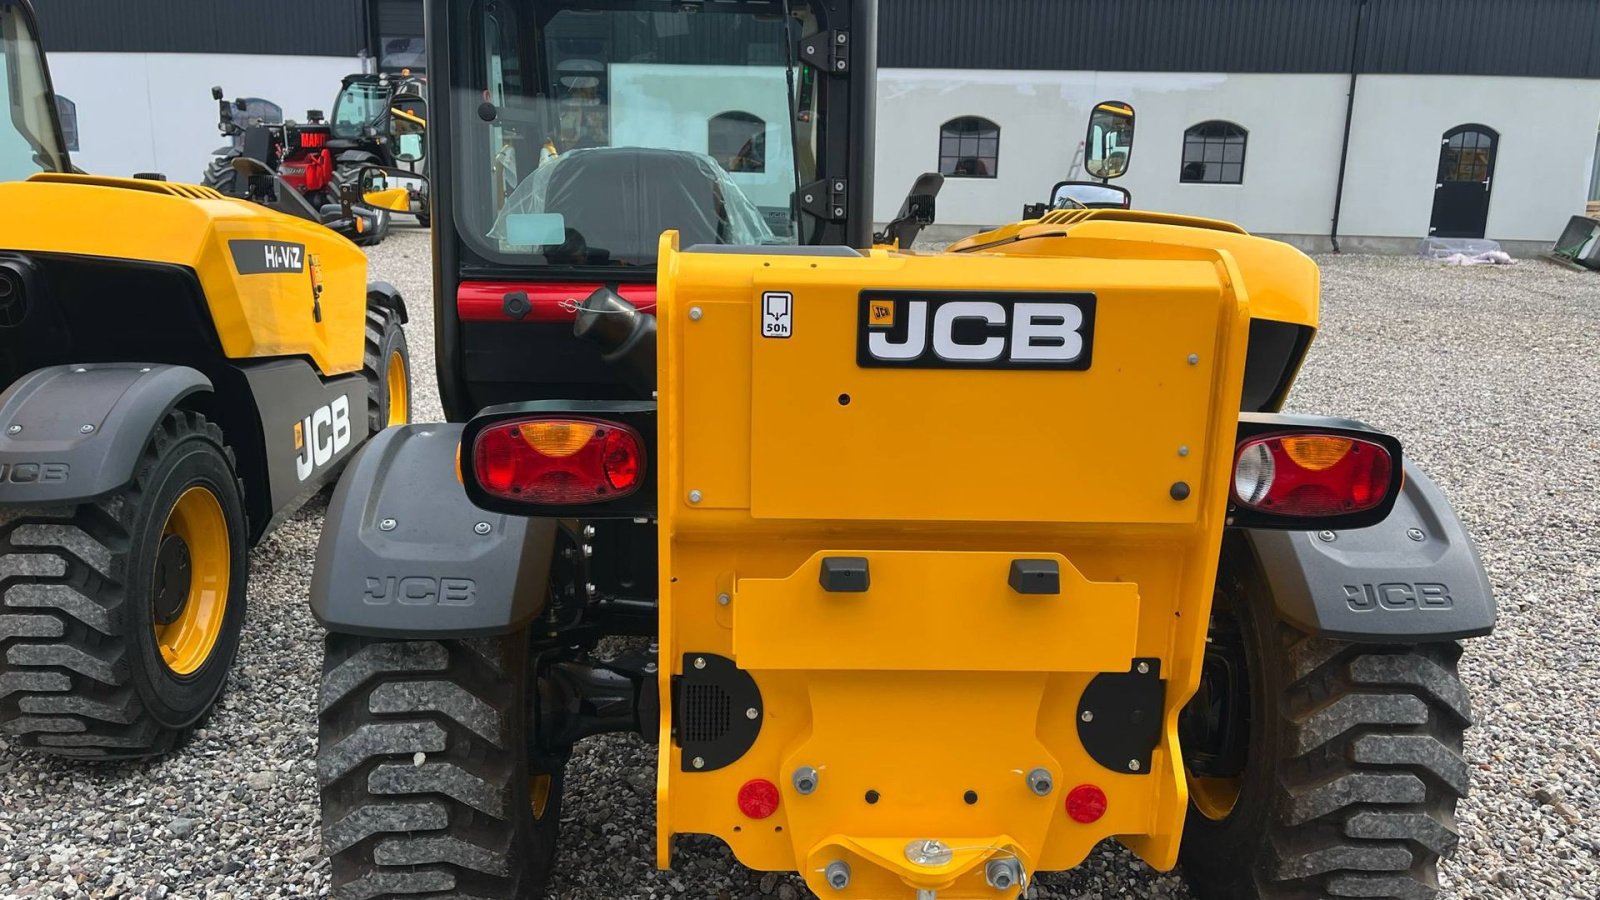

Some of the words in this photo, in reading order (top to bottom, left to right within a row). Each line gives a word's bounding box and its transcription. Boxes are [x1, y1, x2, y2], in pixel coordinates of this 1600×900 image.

[766, 323, 787, 332] 50h
[868, 301, 1083, 360] JCB
[296, 394, 351, 481] JCB
[363, 575, 476, 606] JCB
[1343, 582, 1453, 611] JCB
